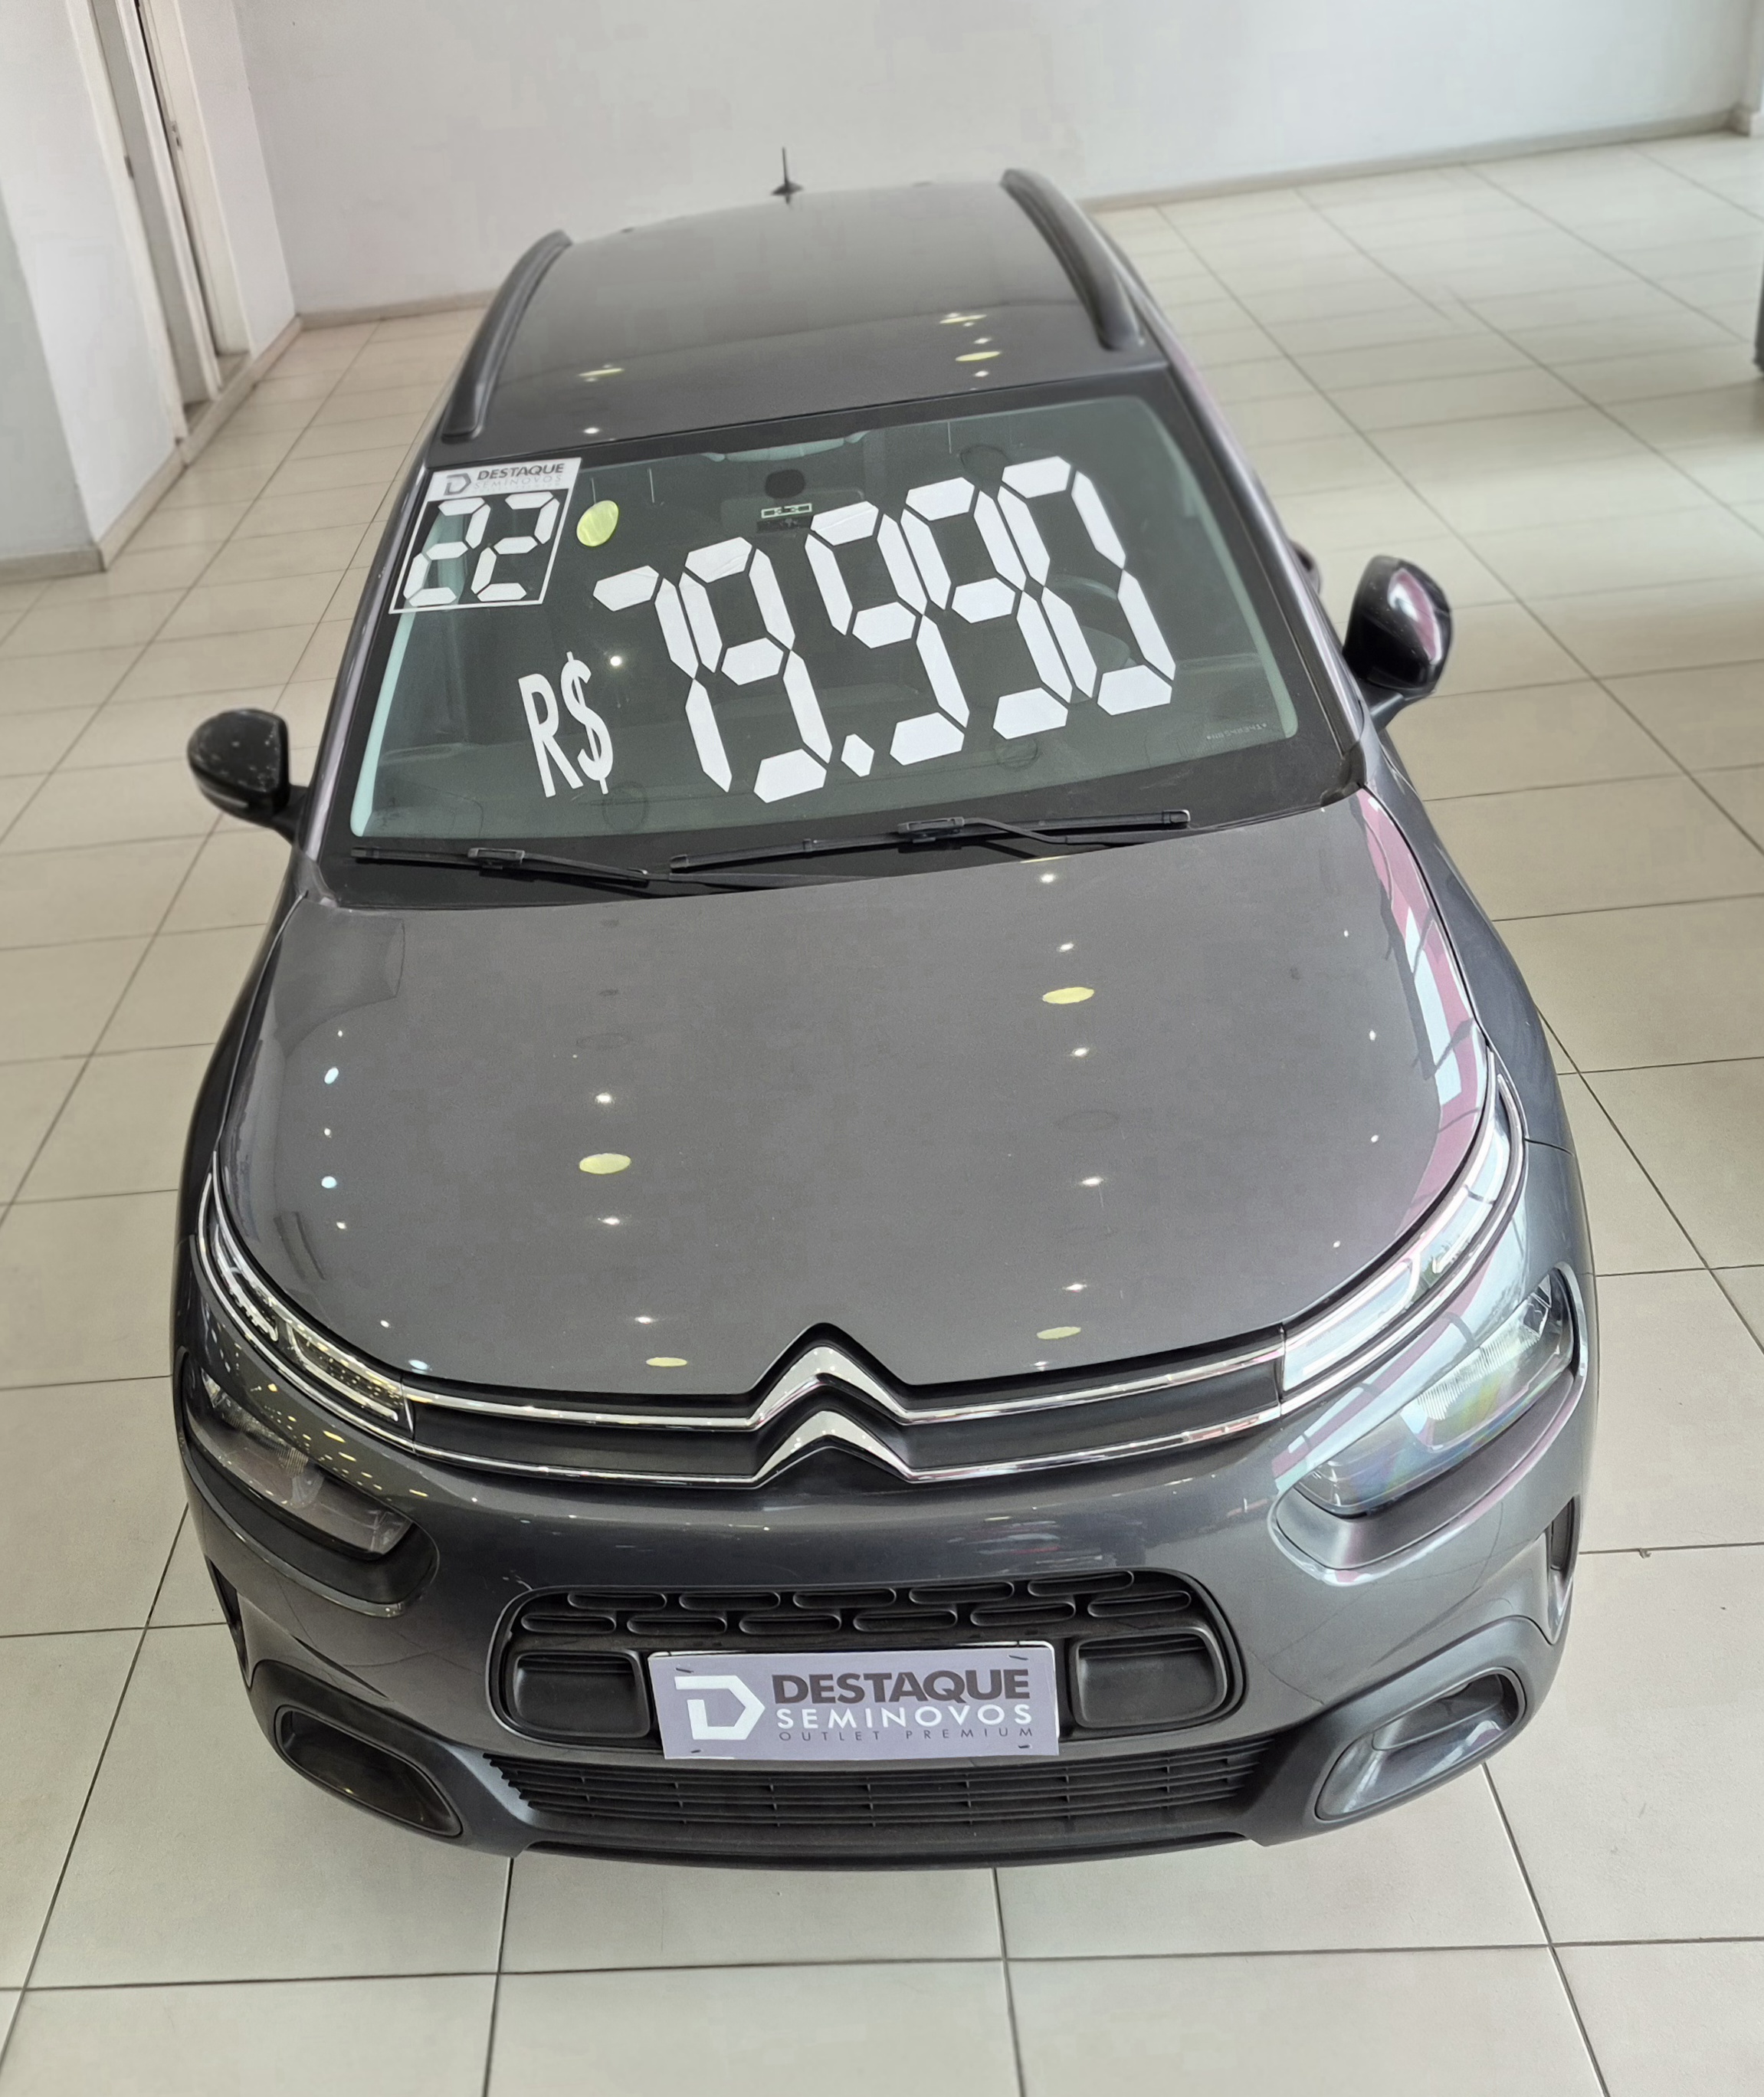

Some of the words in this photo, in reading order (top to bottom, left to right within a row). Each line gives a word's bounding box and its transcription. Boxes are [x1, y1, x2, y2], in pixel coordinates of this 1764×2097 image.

[474, 473, 562, 489] SEMINOVOS
[477, 463, 566, 481] DESTAQUE
[402, 491, 561, 608] 22
[518, 651, 614, 799] R$
[592, 455, 1176, 804] 79.990
[772, 1669, 1031, 1705] DESTAQUE
[776, 1703, 1033, 1729] SEMINOVOS
[778, 1730, 880, 1742] OUTLET
[905, 1727, 1033, 1739] PREMIUM
